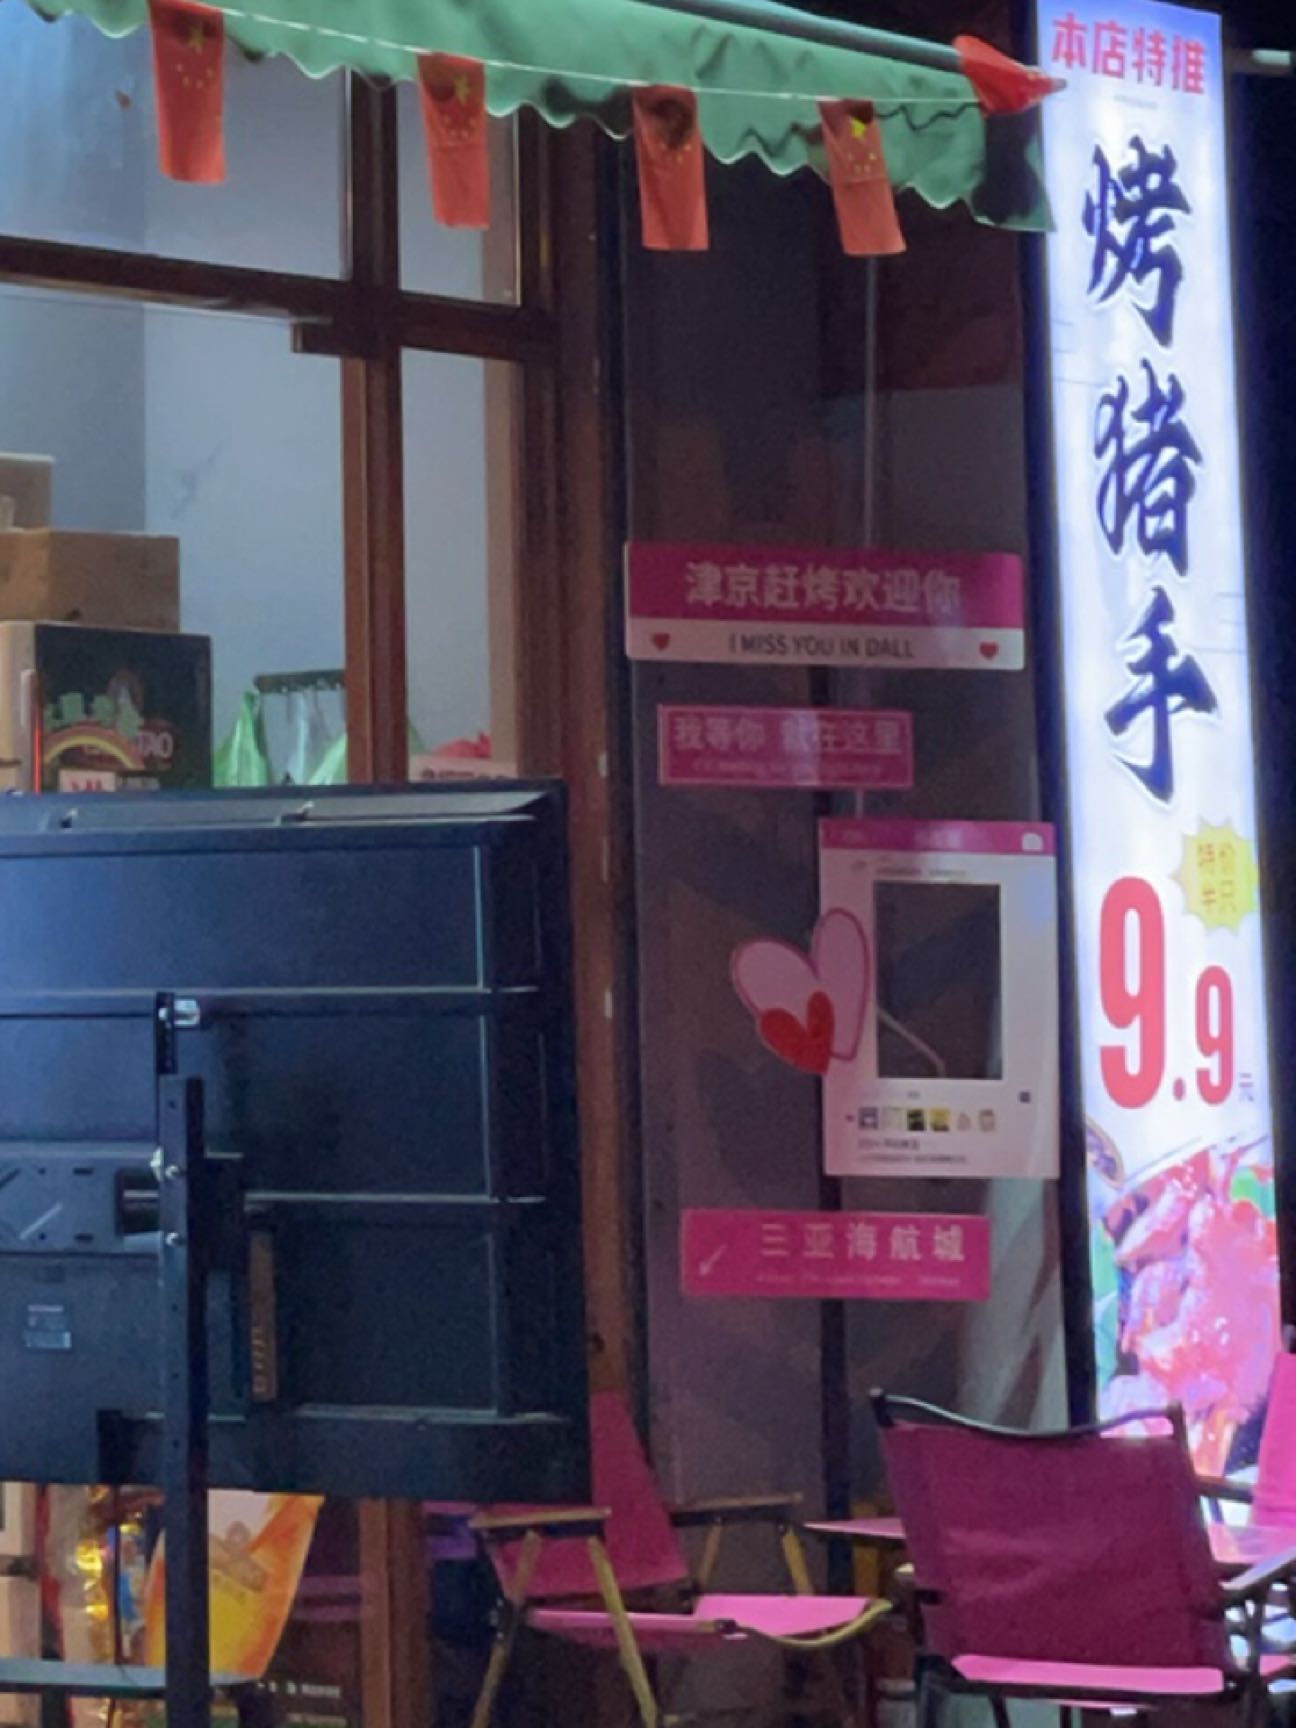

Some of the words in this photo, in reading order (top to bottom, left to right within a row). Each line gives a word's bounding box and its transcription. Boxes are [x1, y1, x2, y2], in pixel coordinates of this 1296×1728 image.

[1052, 11, 1206, 94] 本店特推
[1082, 135, 1219, 804] 烤猪手
[684, 560, 961, 615] 津京赶烤欢迎你
[742, 637, 787, 656] MISS
[792, 638, 835, 657] YOU
[839, 639, 860, 657] IN
[1100, 876, 1235, 1110] 9.9
